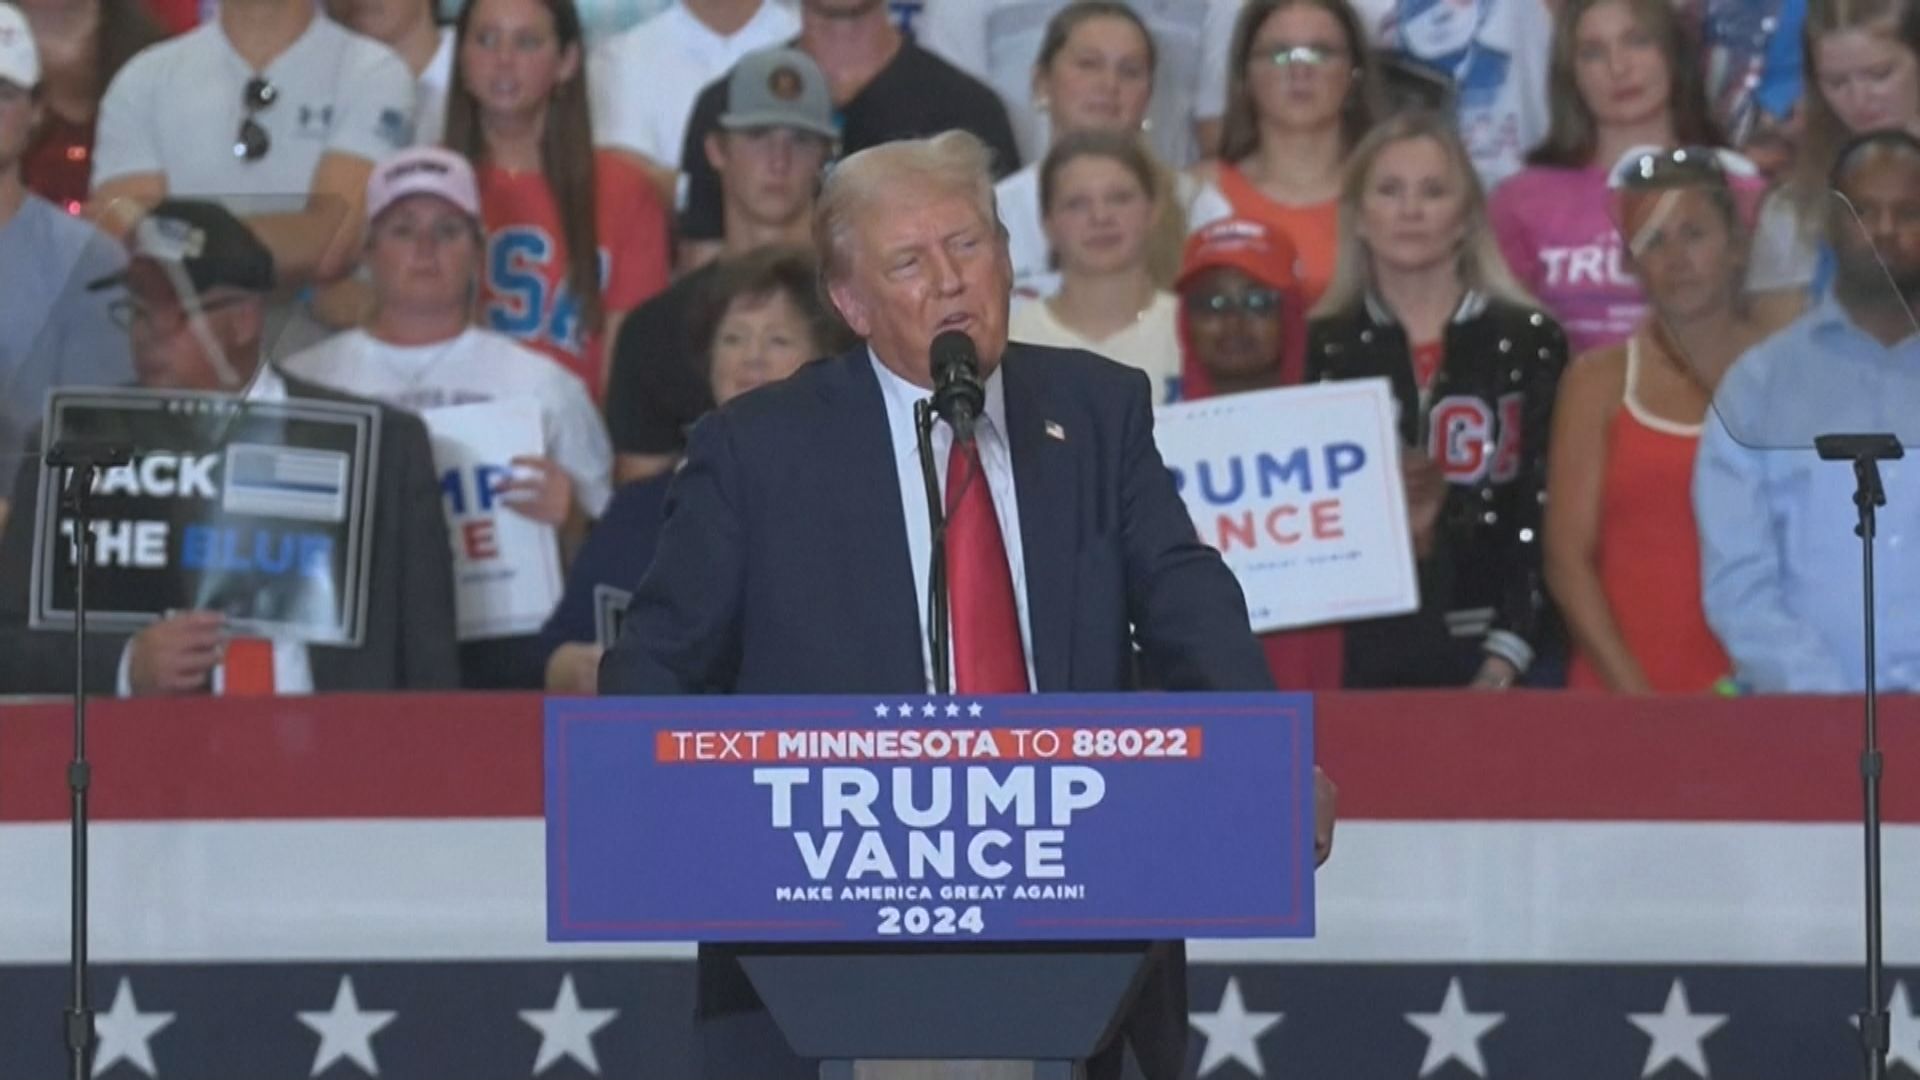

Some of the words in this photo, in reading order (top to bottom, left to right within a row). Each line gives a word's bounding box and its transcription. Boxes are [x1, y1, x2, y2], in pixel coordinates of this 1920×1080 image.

[62, 453, 219, 497] ACK
[60, 519, 170, 568] THE
[180, 523, 334, 577] BLUE
[672, 731, 766, 760] TEXT
[777, 729, 1000, 759] MINNESOTA
[1010, 728, 1060, 758] TO
[1071, 728, 1188, 758] 88022
[753, 766, 1107, 828] TRUMP
[793, 829, 1066, 880] VANCE
[775, 886, 833, 901] MAKE
[840, 886, 933, 901] AMERICA
[940, 885, 1007, 900] GREAT
[1012, 884, 1086, 900] AGAIN!
[876, 906, 985, 935] 2024
